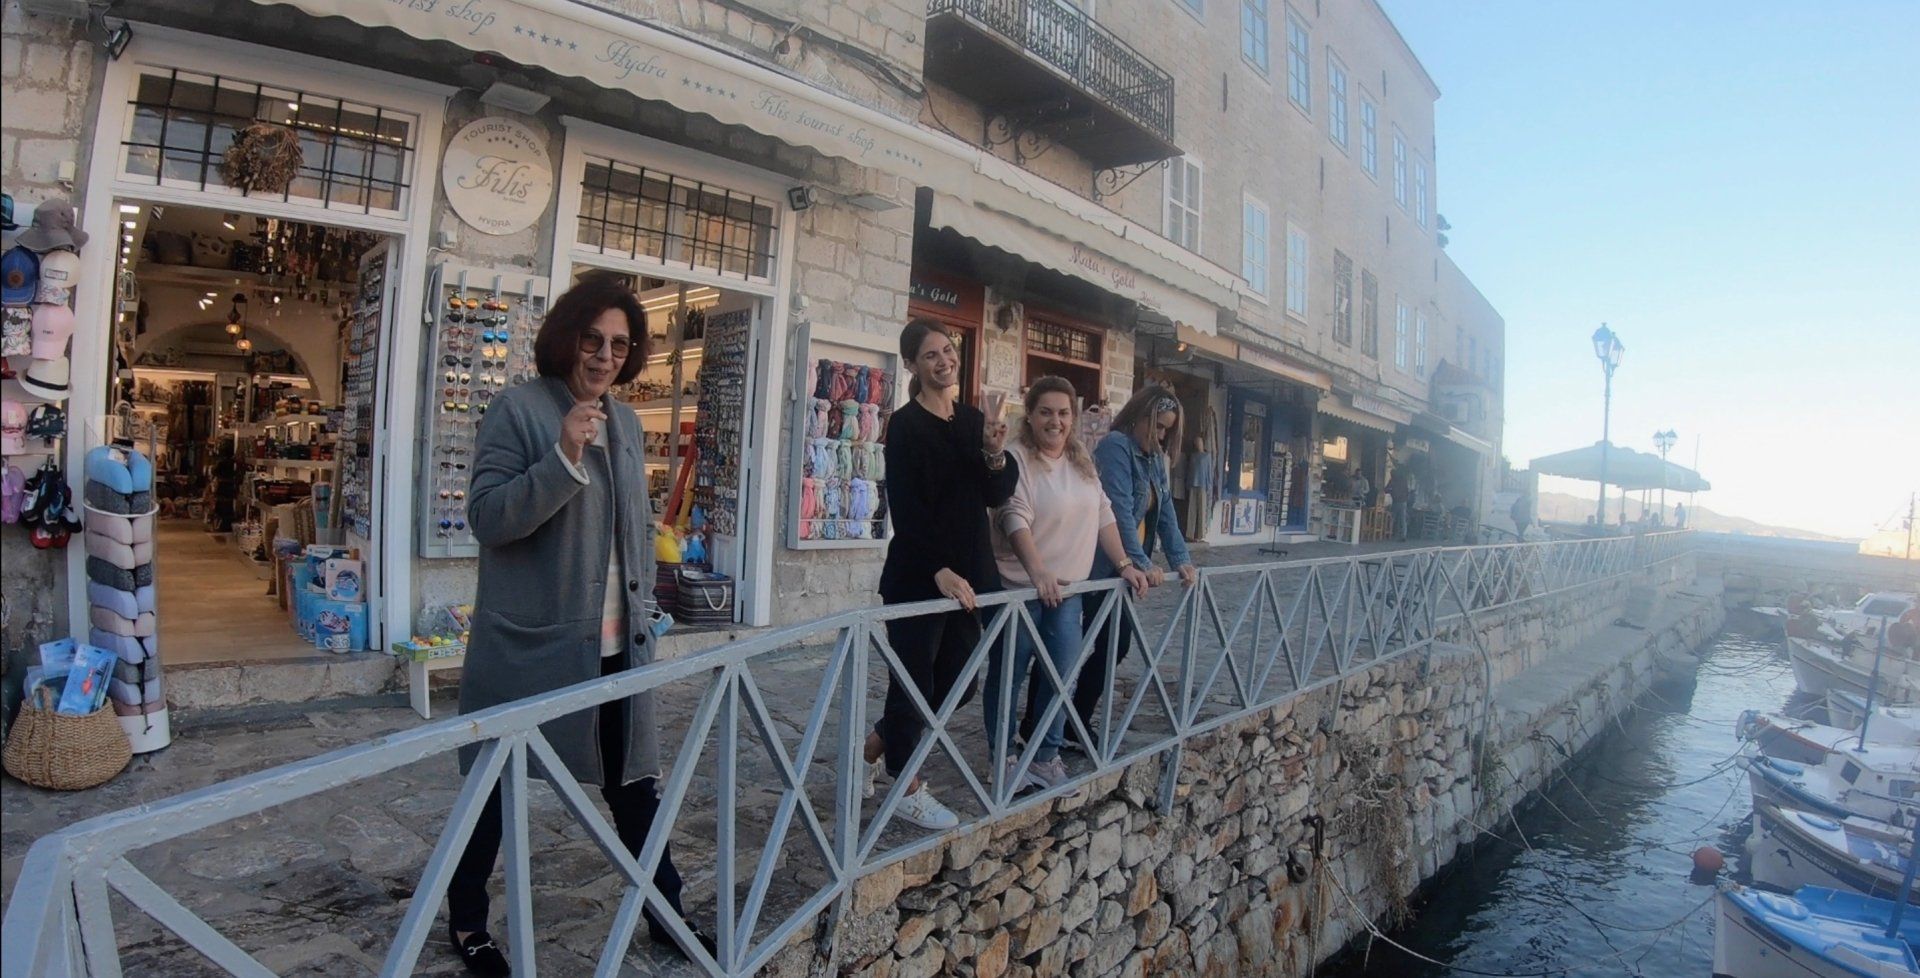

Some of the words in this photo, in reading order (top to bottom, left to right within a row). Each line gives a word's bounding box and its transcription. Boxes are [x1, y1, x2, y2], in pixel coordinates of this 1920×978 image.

[445, 0, 497, 36] shop
[594, 40, 667, 79] Hydra
[463, 123, 513, 142] TOURIST
[514, 130, 542, 157] SHOP
[750, 90, 790, 121] Filis
[796, 110, 845, 137] tourist
[847, 127, 875, 158] shop
[457, 154, 534, 199] Filis
[478, 216, 512, 228] HYDRA
[1111, 267, 1136, 289] Gold
[930, 287, 958, 305] Gold
